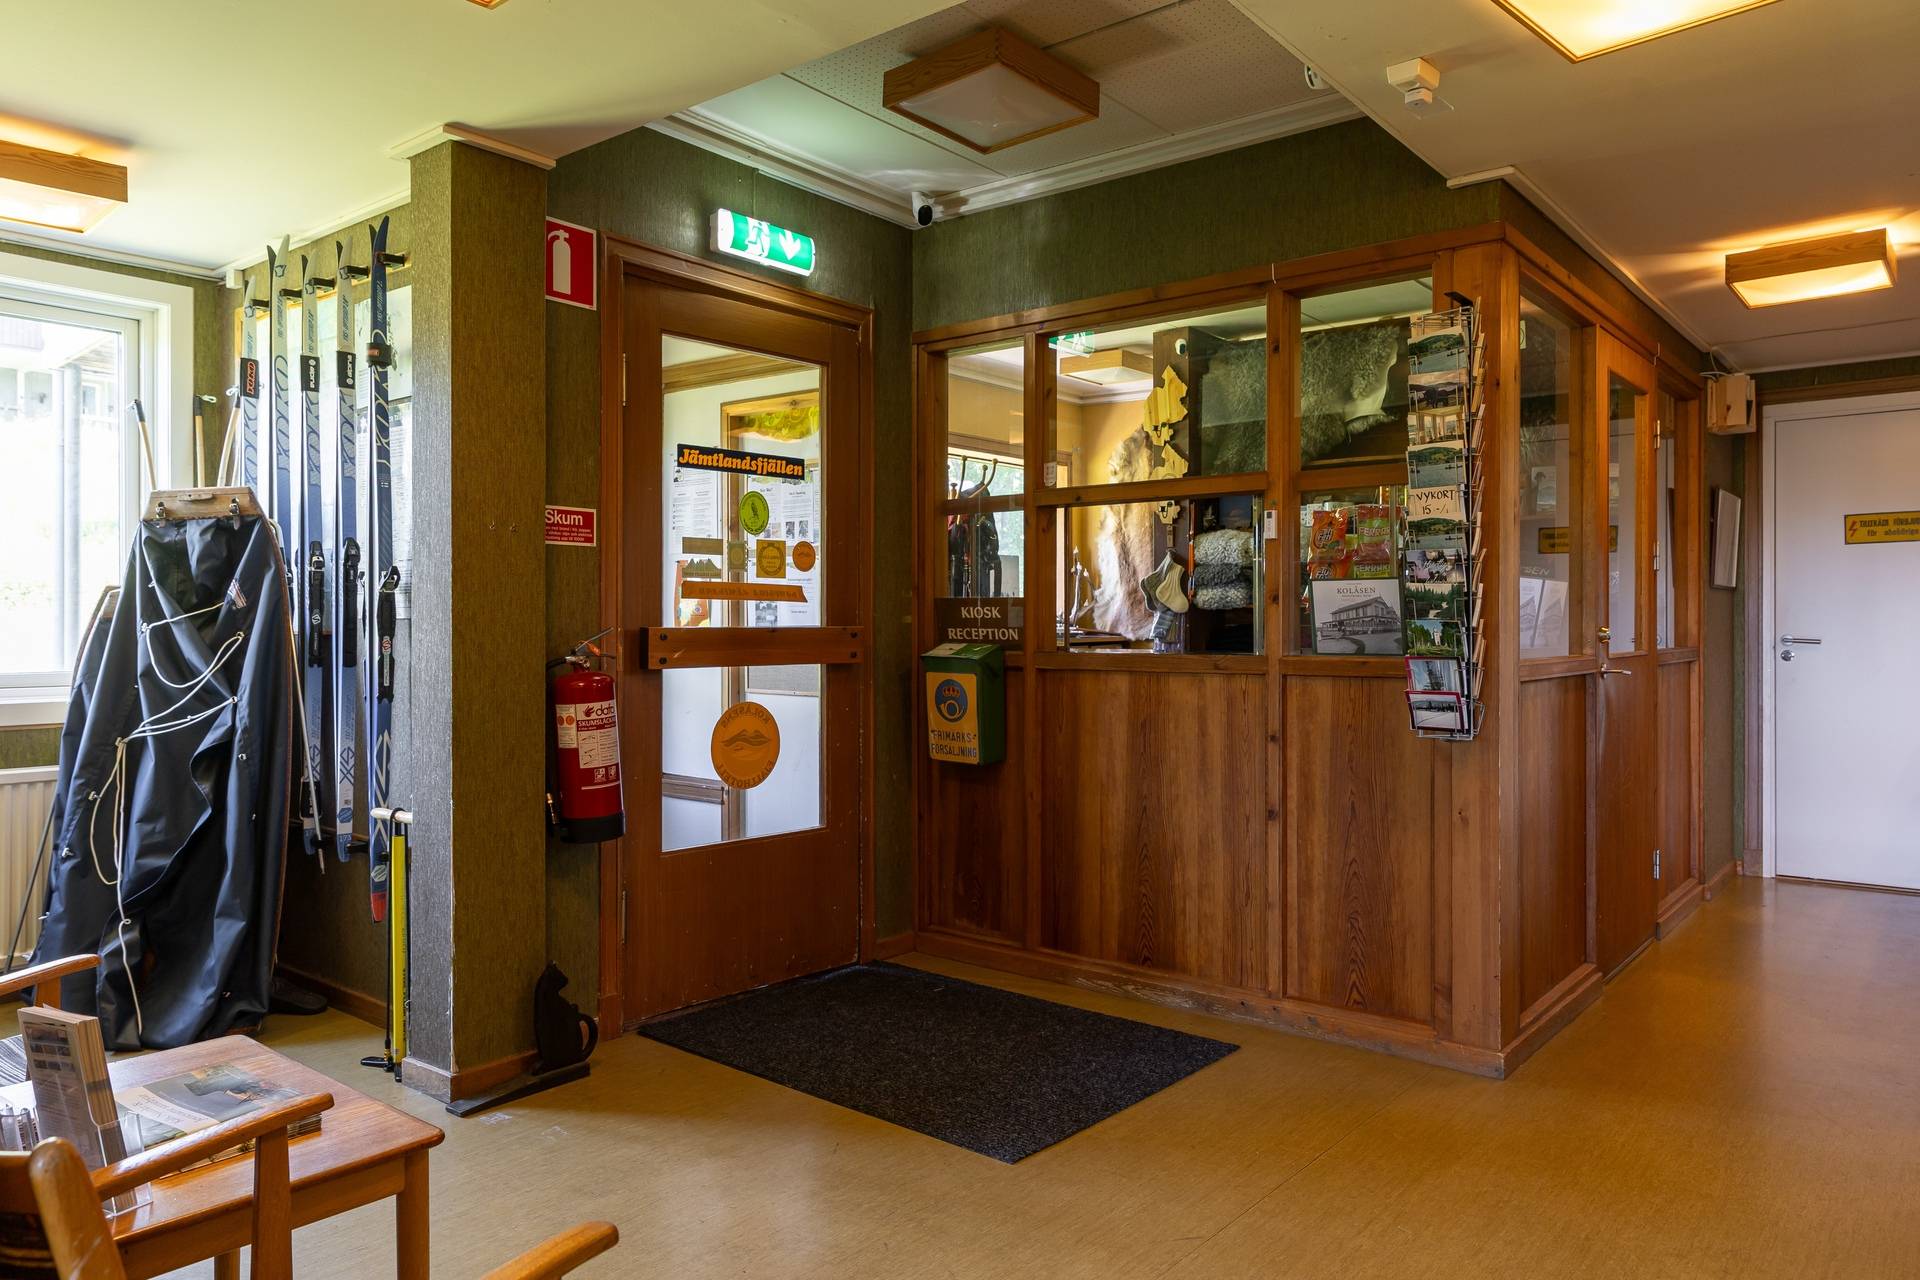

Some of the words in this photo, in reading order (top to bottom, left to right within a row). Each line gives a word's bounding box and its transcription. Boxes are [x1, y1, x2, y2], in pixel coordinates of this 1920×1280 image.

[679, 448, 803, 476] Jämtlandsfjällen
[1416, 489, 1455, 503] VYKORT
[545, 509, 583, 526] Skum
[1336, 585, 1376, 595] KOLÅSEN
[961, 606, 1001, 619] KIOSK
[948, 627, 1019, 641] RECEPTION
